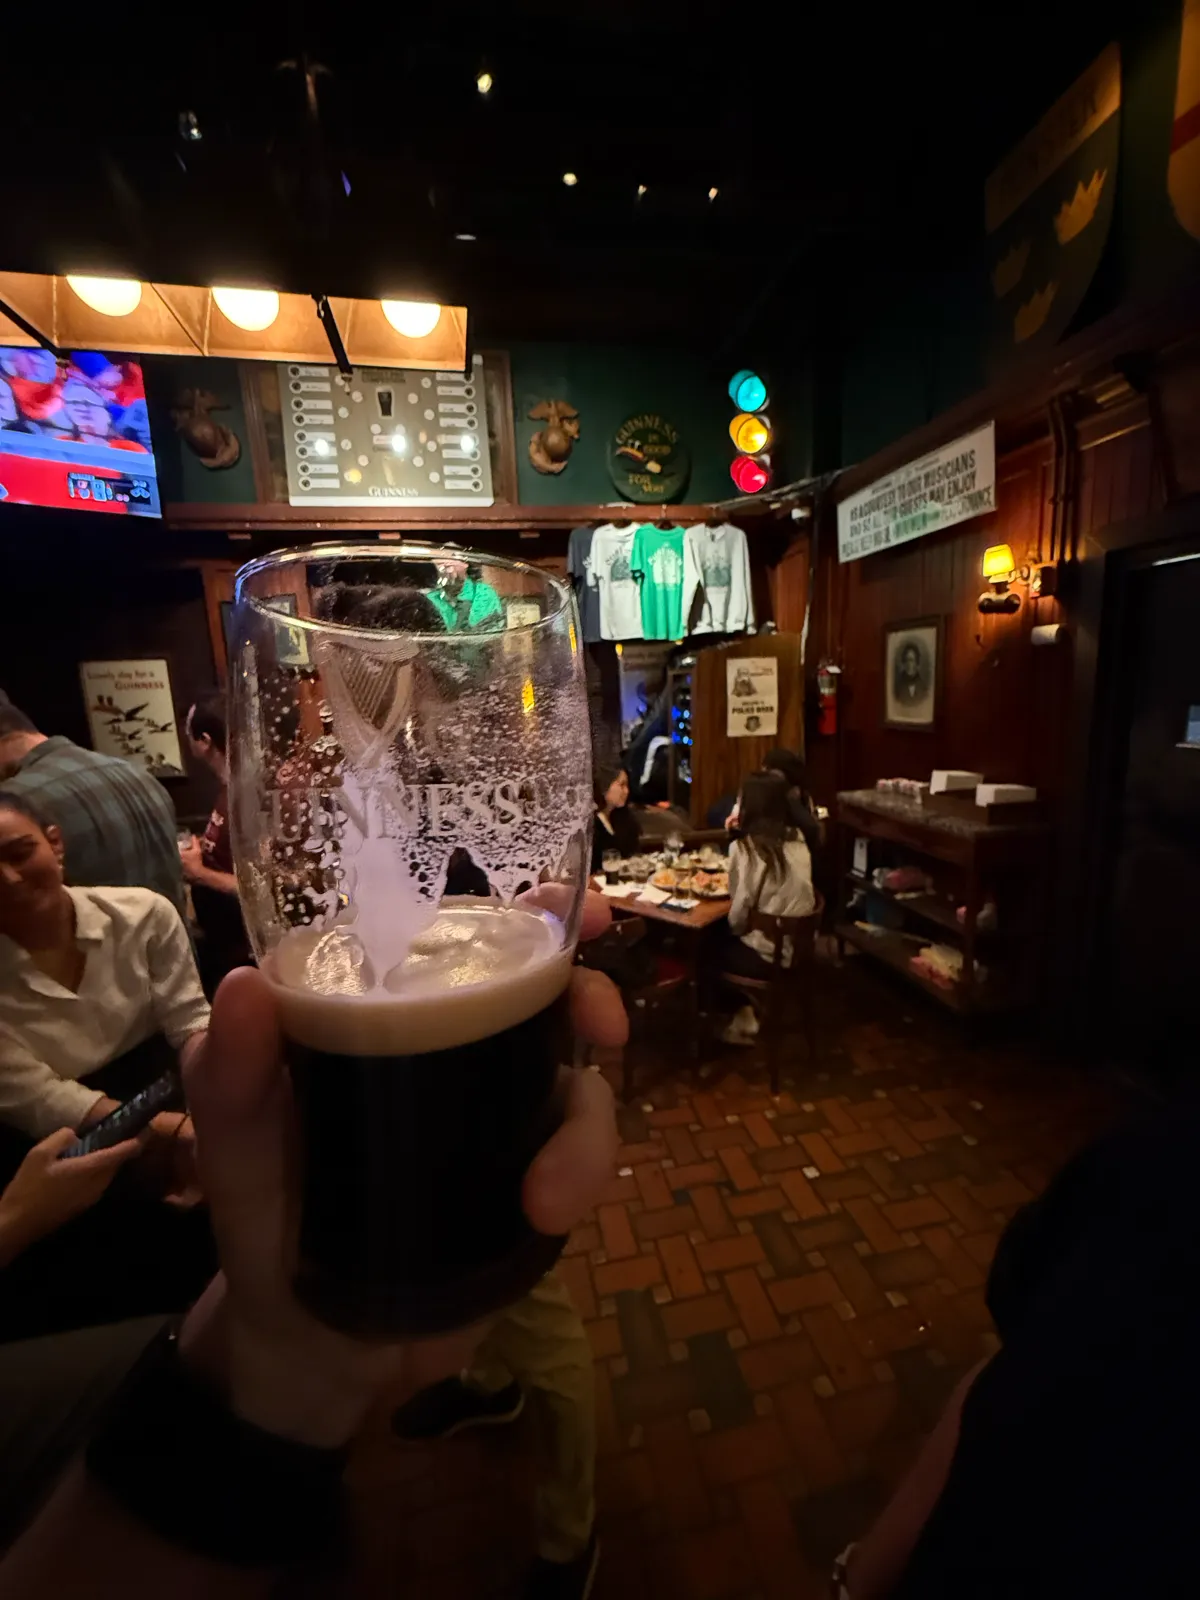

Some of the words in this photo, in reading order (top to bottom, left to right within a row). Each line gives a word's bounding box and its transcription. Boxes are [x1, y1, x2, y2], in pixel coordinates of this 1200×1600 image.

[615, 414, 678, 444] GUINNESS
[923, 449, 975, 489] MUSICIANS
[368, 486, 419, 497] GUINNESS
[948, 470, 977, 500] ENJOY
[115, 681, 164, 690] GUINNESS
[118, 671, 133, 680] day
